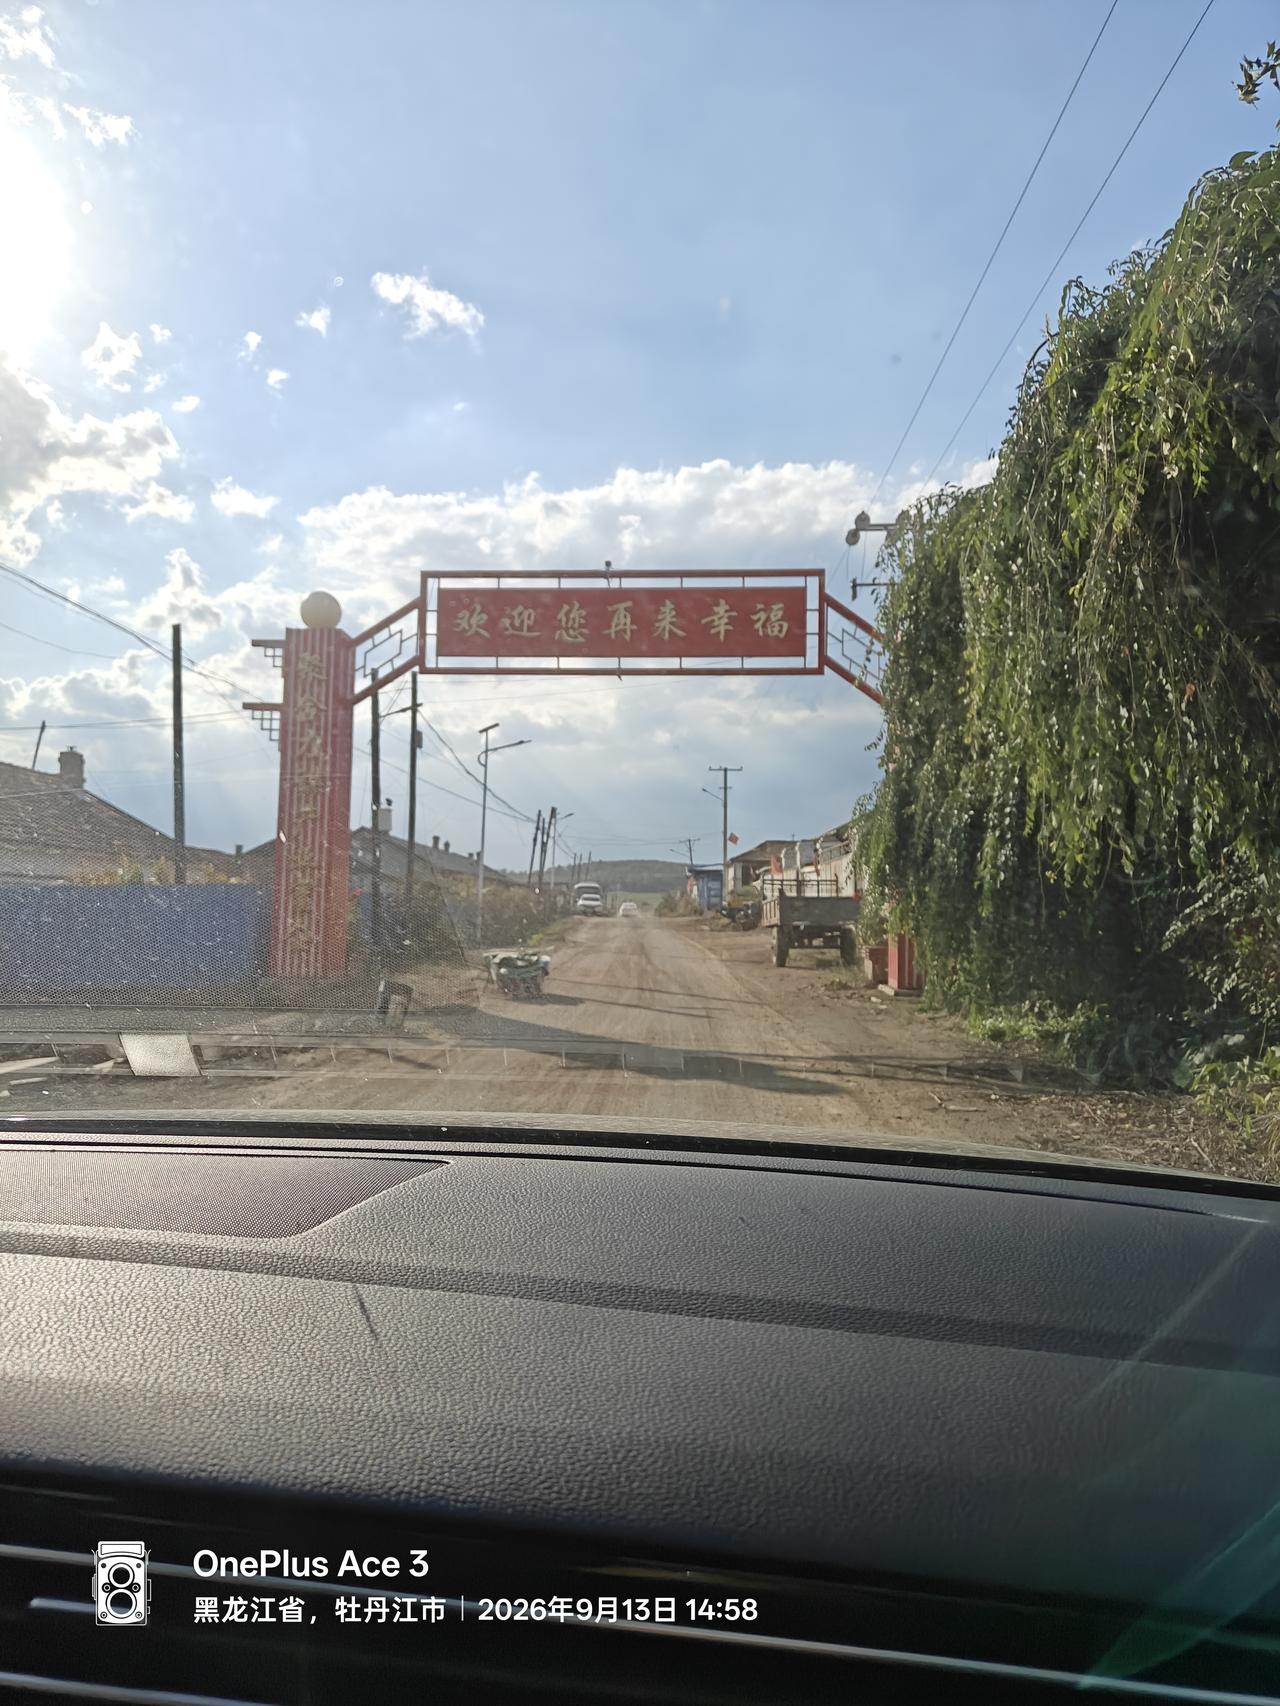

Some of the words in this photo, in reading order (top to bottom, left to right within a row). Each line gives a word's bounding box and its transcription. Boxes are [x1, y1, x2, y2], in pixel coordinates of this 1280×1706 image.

[452, 599, 789, 644] 欢迎您再来幸福
